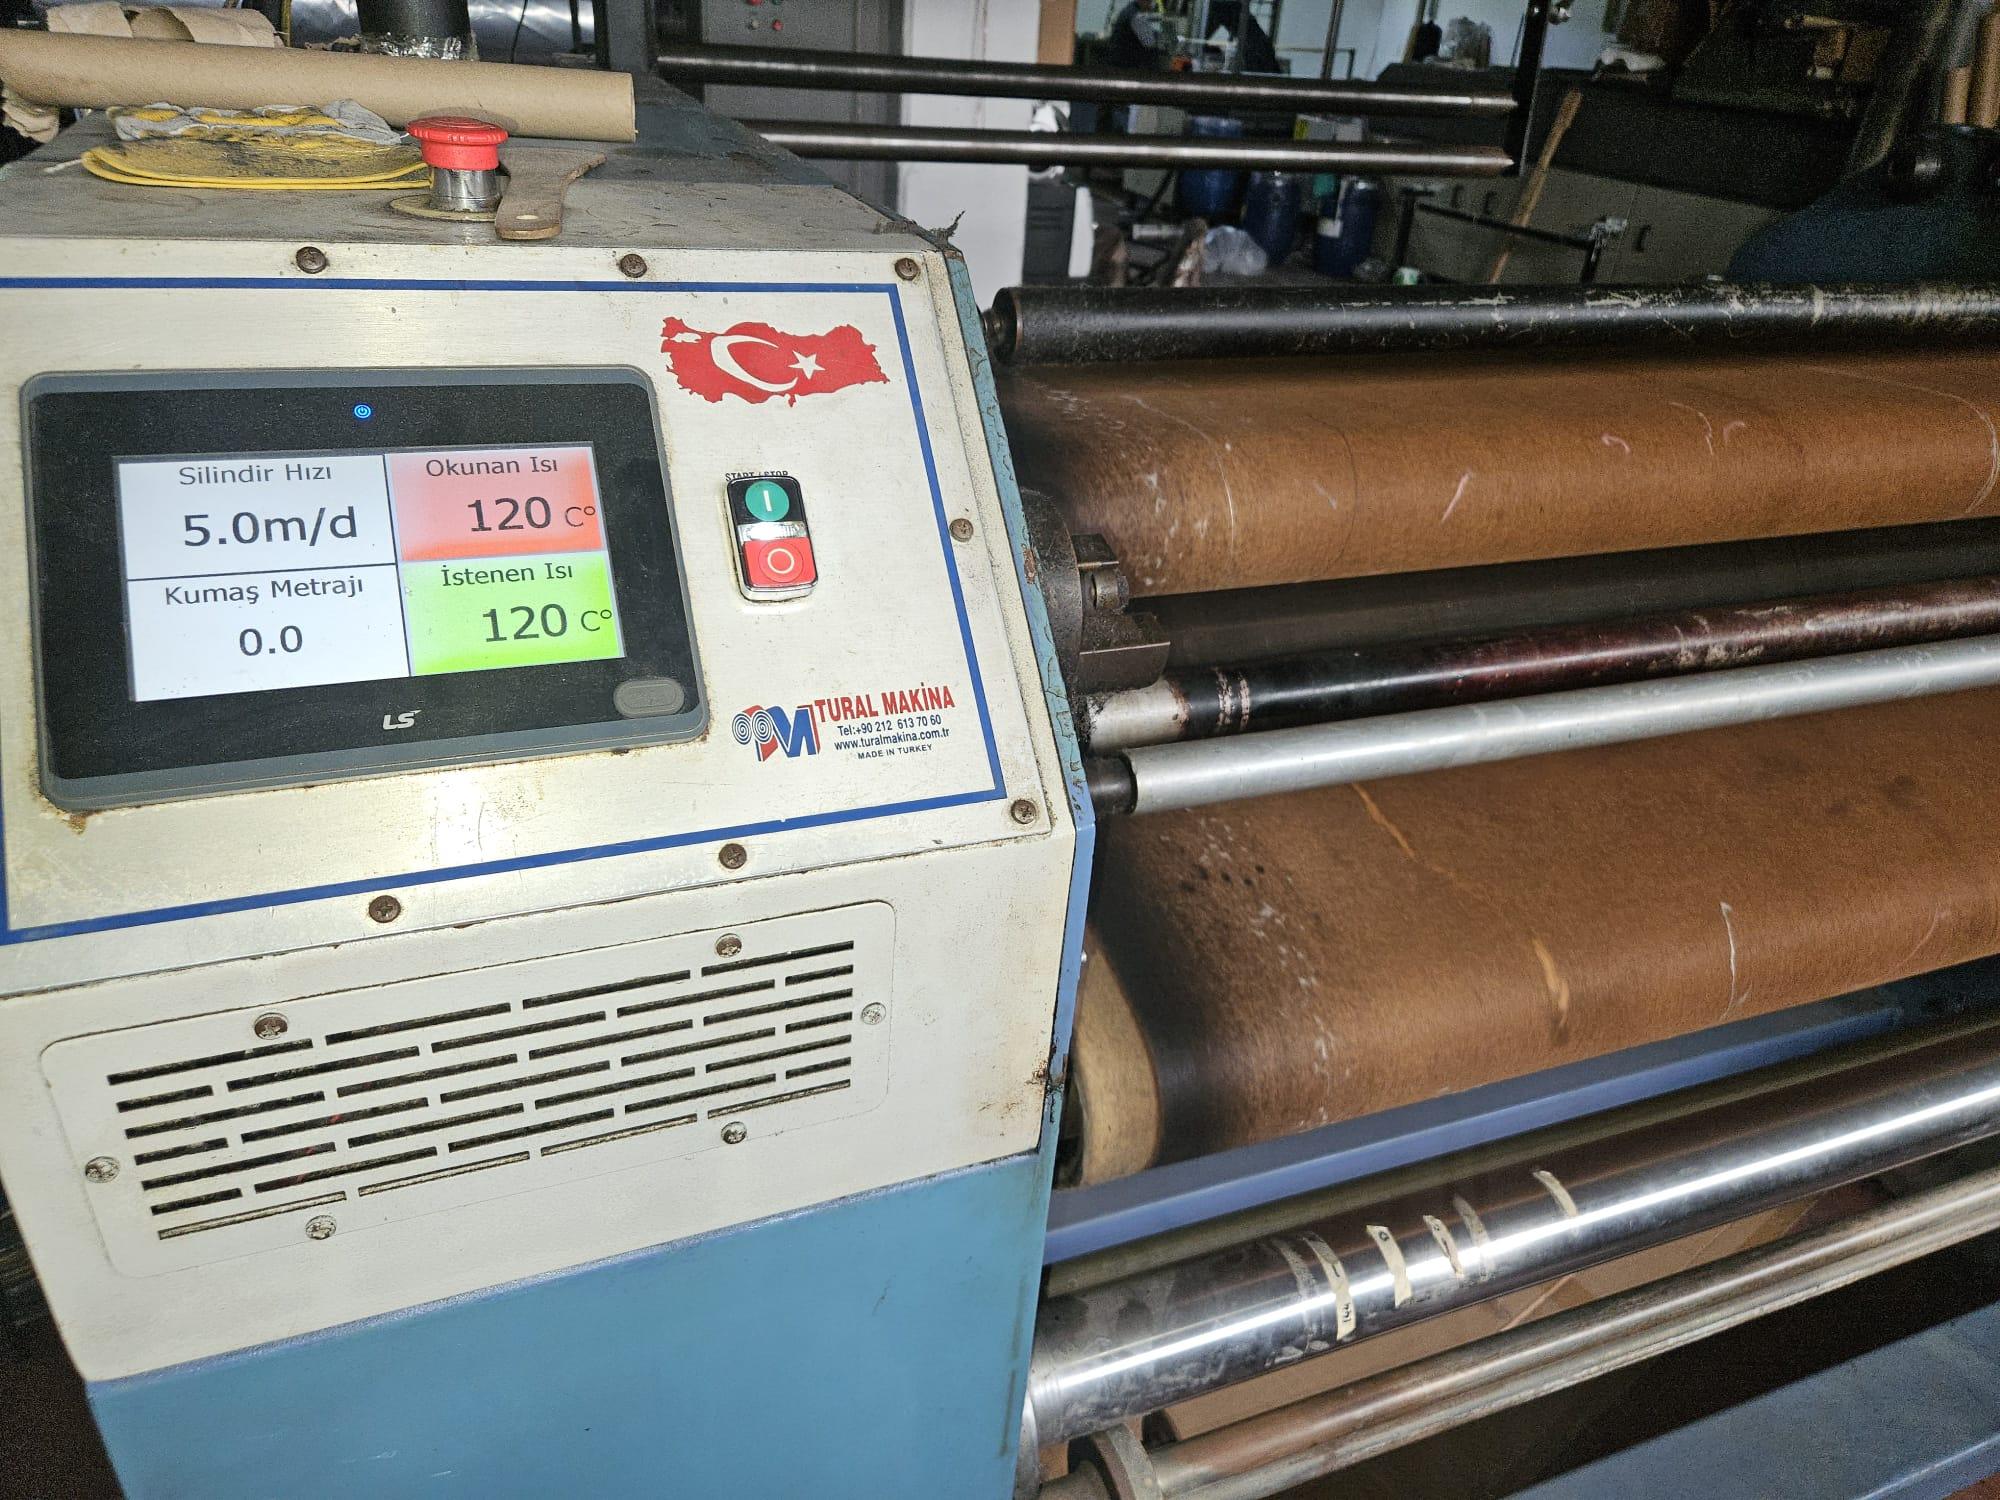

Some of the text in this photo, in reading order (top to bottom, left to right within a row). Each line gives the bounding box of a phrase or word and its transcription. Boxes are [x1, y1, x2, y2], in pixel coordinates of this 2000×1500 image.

[179, 464, 332, 485] Silindir Hızı
[426, 456, 558, 477] Okunan Isı
[467, 496, 552, 532] 120
[184, 506, 358, 547] 5.0m/d
[441, 562, 573, 586] İstenen Isı
[165, 576, 364, 605] Kumaş Metrajı
[482, 603, 568, 643] 120
[239, 625, 303, 656] 0.0
[814, 681, 956, 723] TURAL MAKİNA
[382, 709, 422, 730] LS
[874, 720, 893, 733] 212
[897, 717, 915, 730] 613
[917, 716, 928, 727] 70
[930, 714, 942, 725] 60
[834, 727, 951, 751] www.turalmakina.com.tr
[857, 744, 933, 760] MADE IN TURKEY
